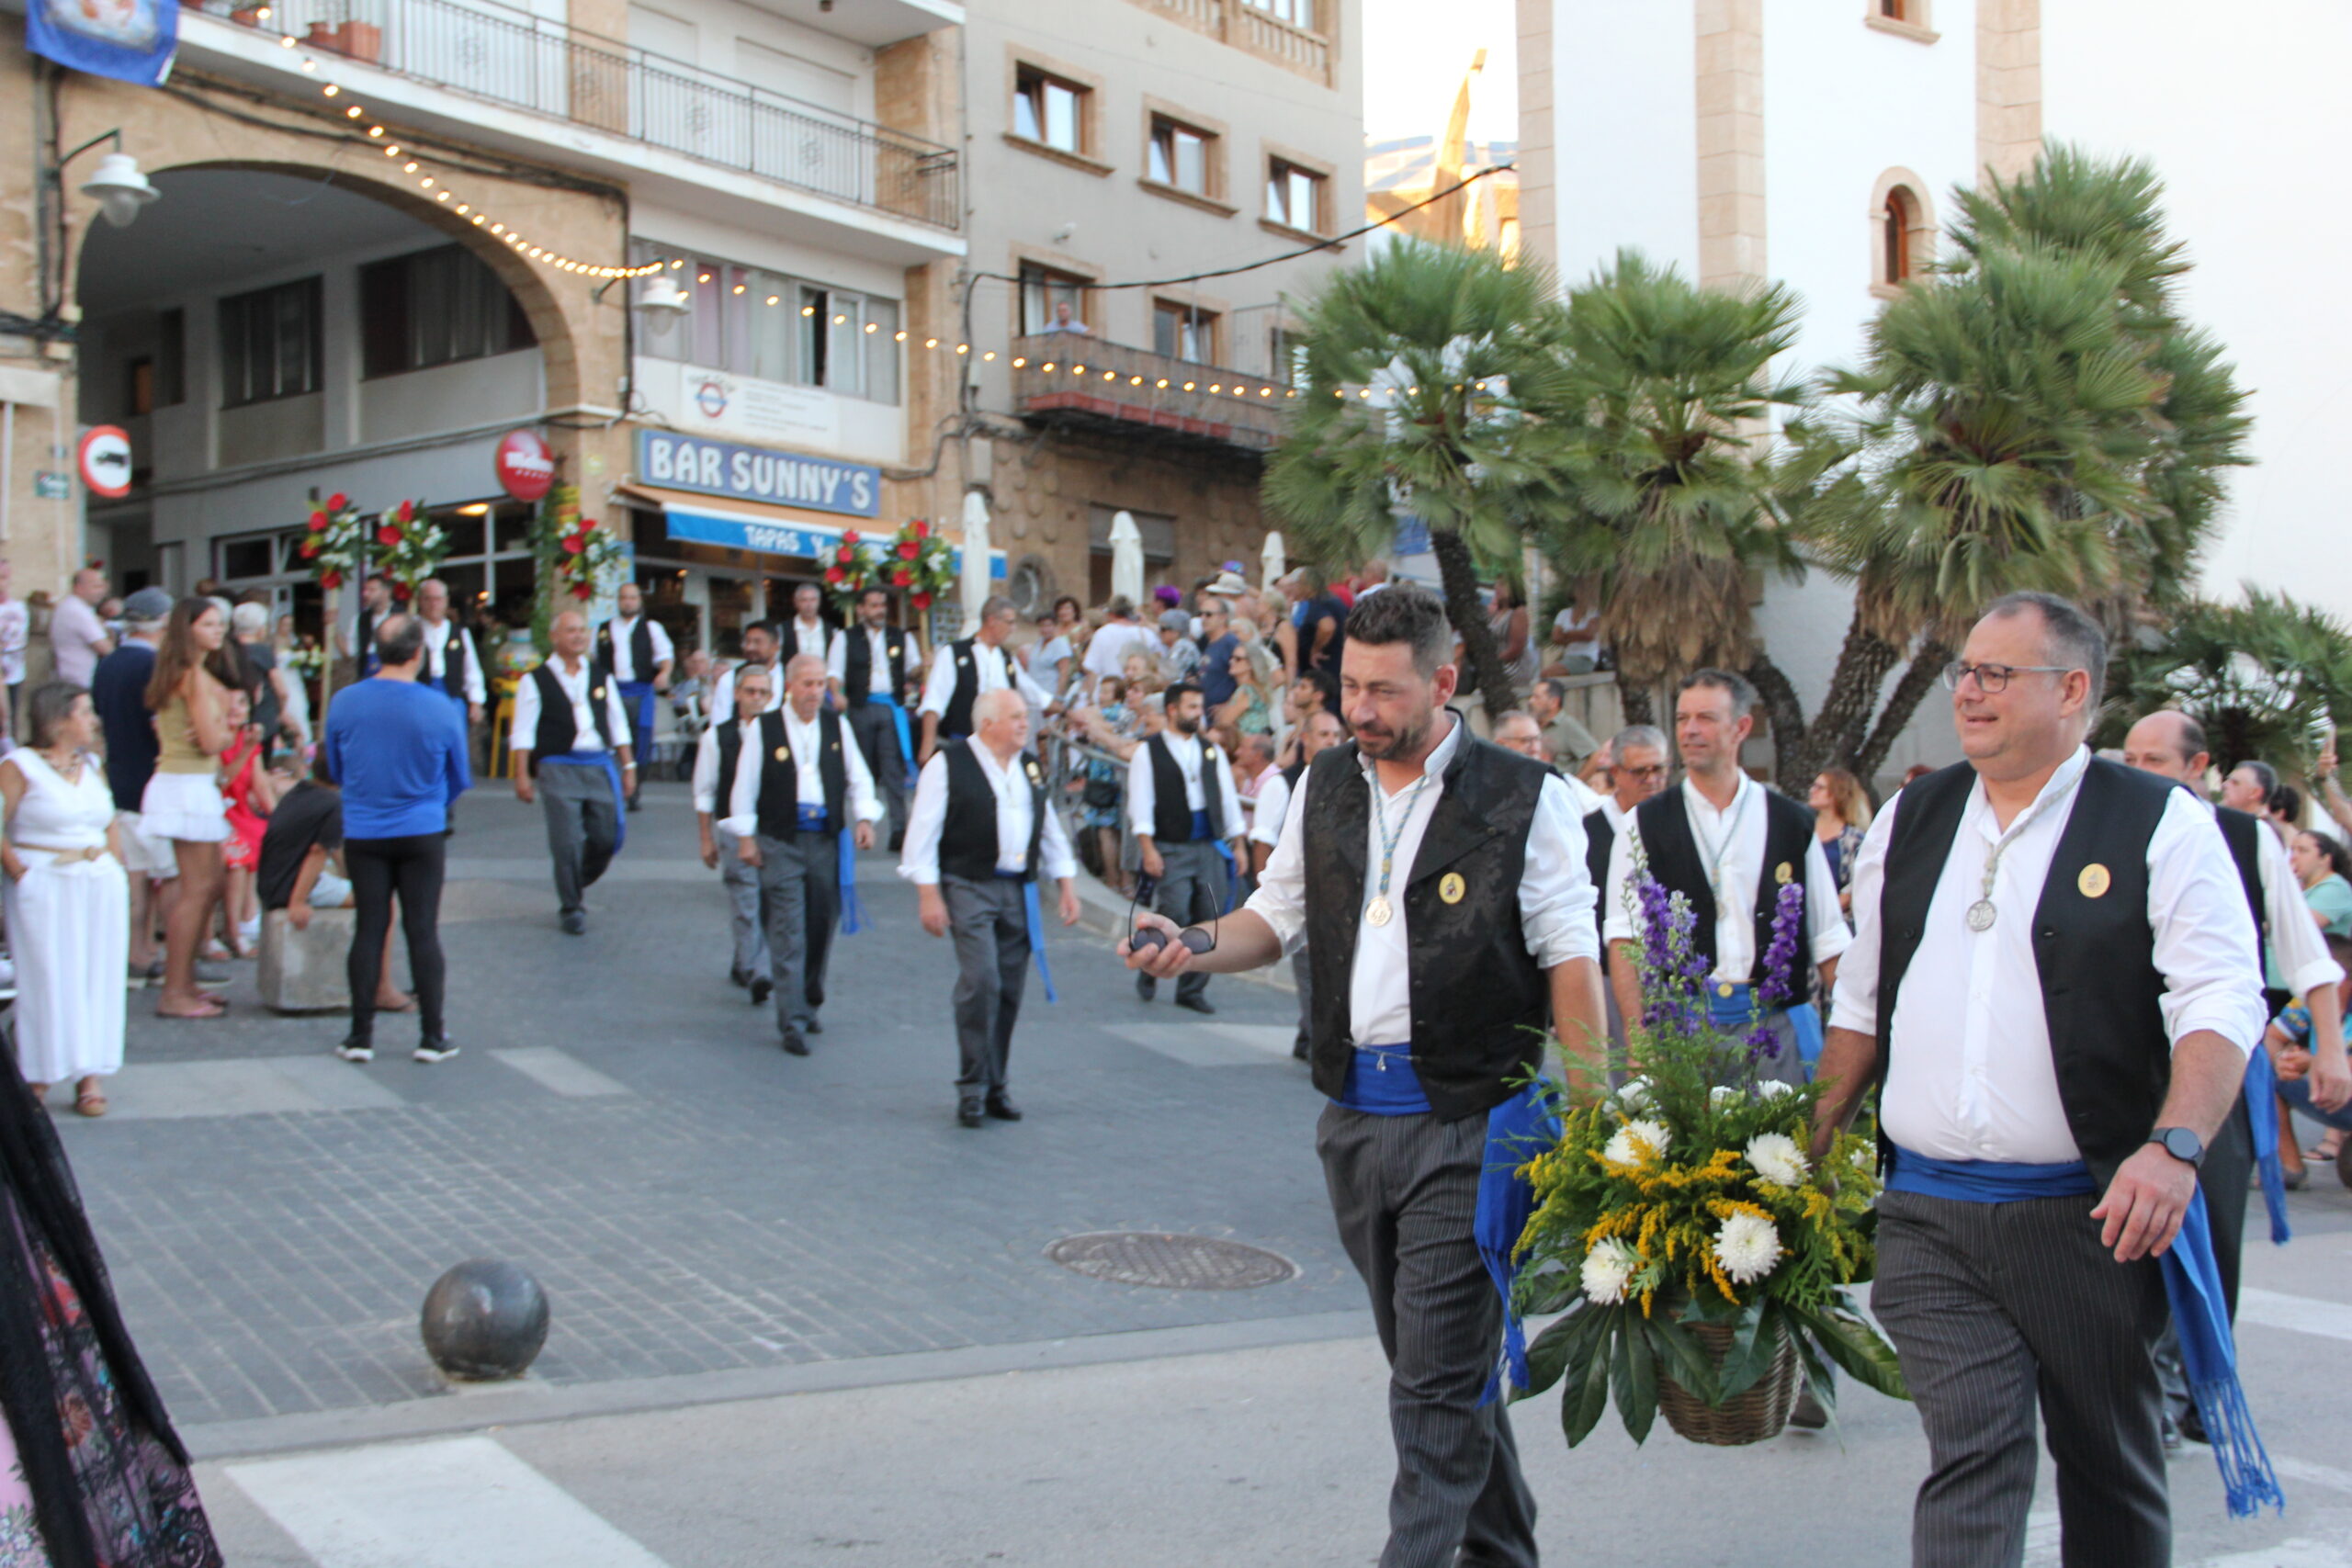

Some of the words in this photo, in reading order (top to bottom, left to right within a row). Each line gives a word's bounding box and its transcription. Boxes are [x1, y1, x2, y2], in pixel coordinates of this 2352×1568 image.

[650, 438, 723, 488] BAR
[731, 451, 871, 510] SUNNY'S
[745, 525, 801, 552] TAPAS
